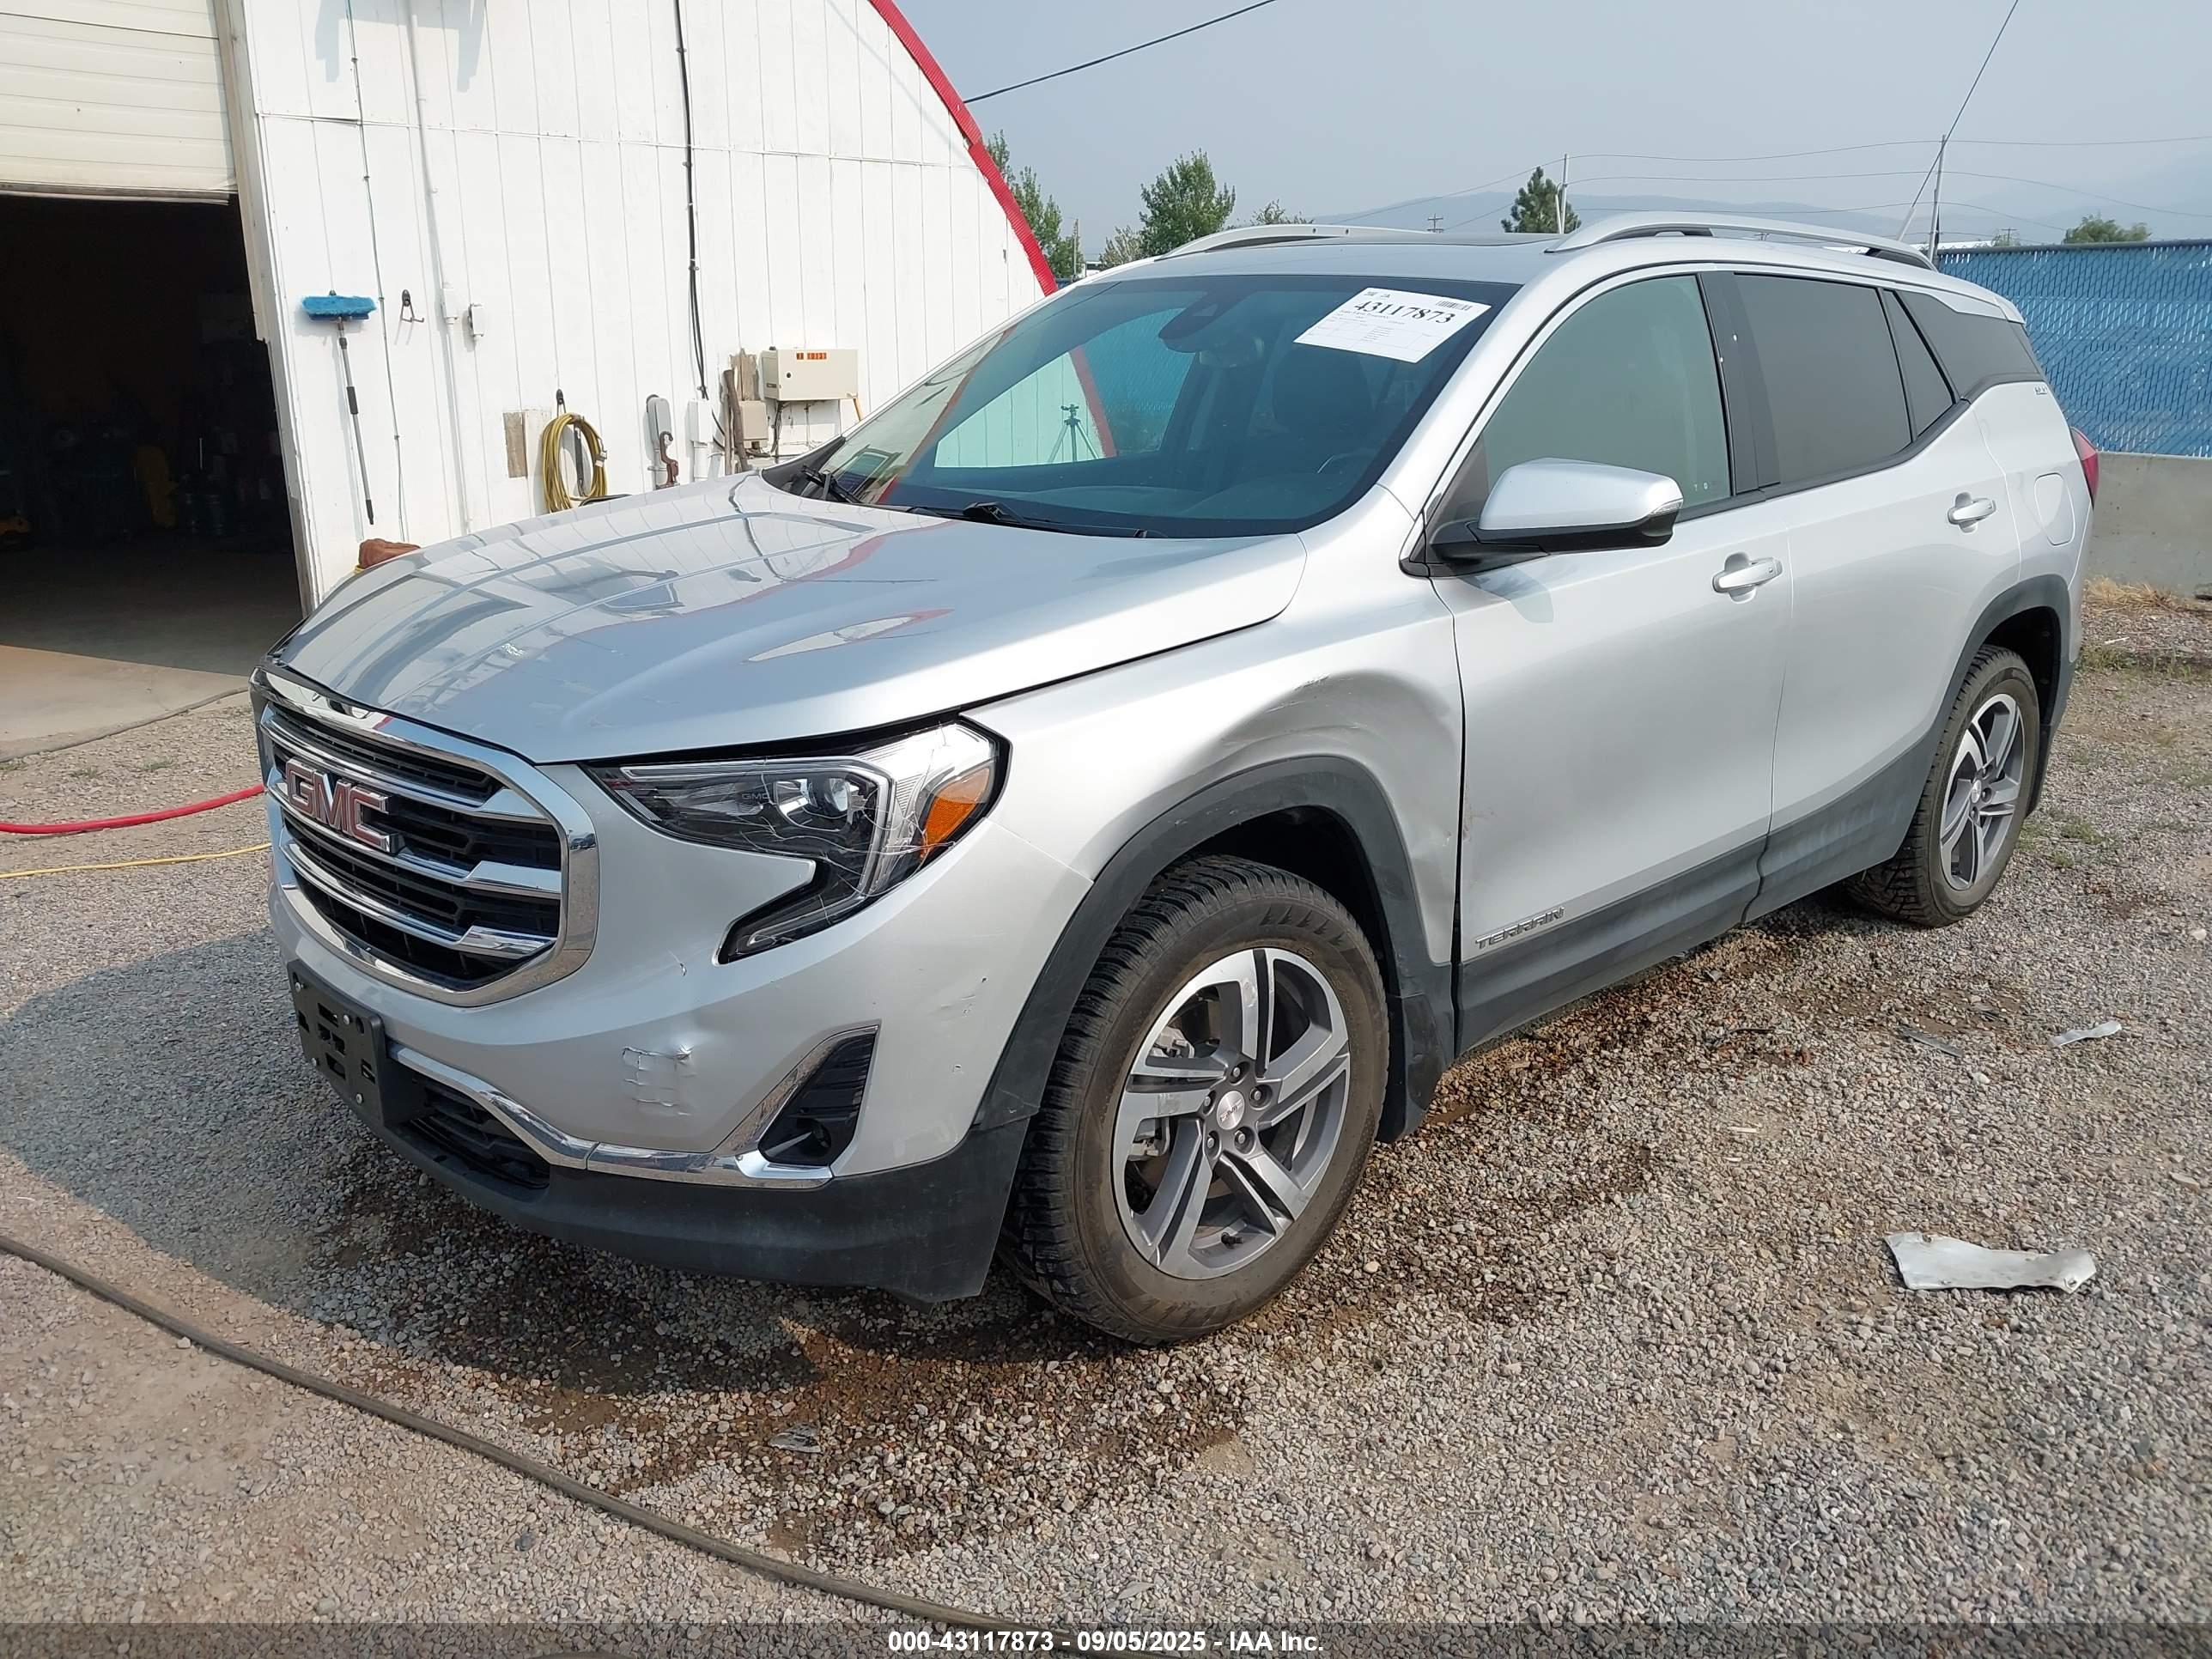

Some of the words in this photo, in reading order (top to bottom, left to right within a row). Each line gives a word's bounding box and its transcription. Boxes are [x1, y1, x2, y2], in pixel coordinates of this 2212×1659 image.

[1353, 301, 1456, 324] 43117873
[285, 757, 390, 854] GMC
[1475, 907, 1565, 949] TERRAIN
